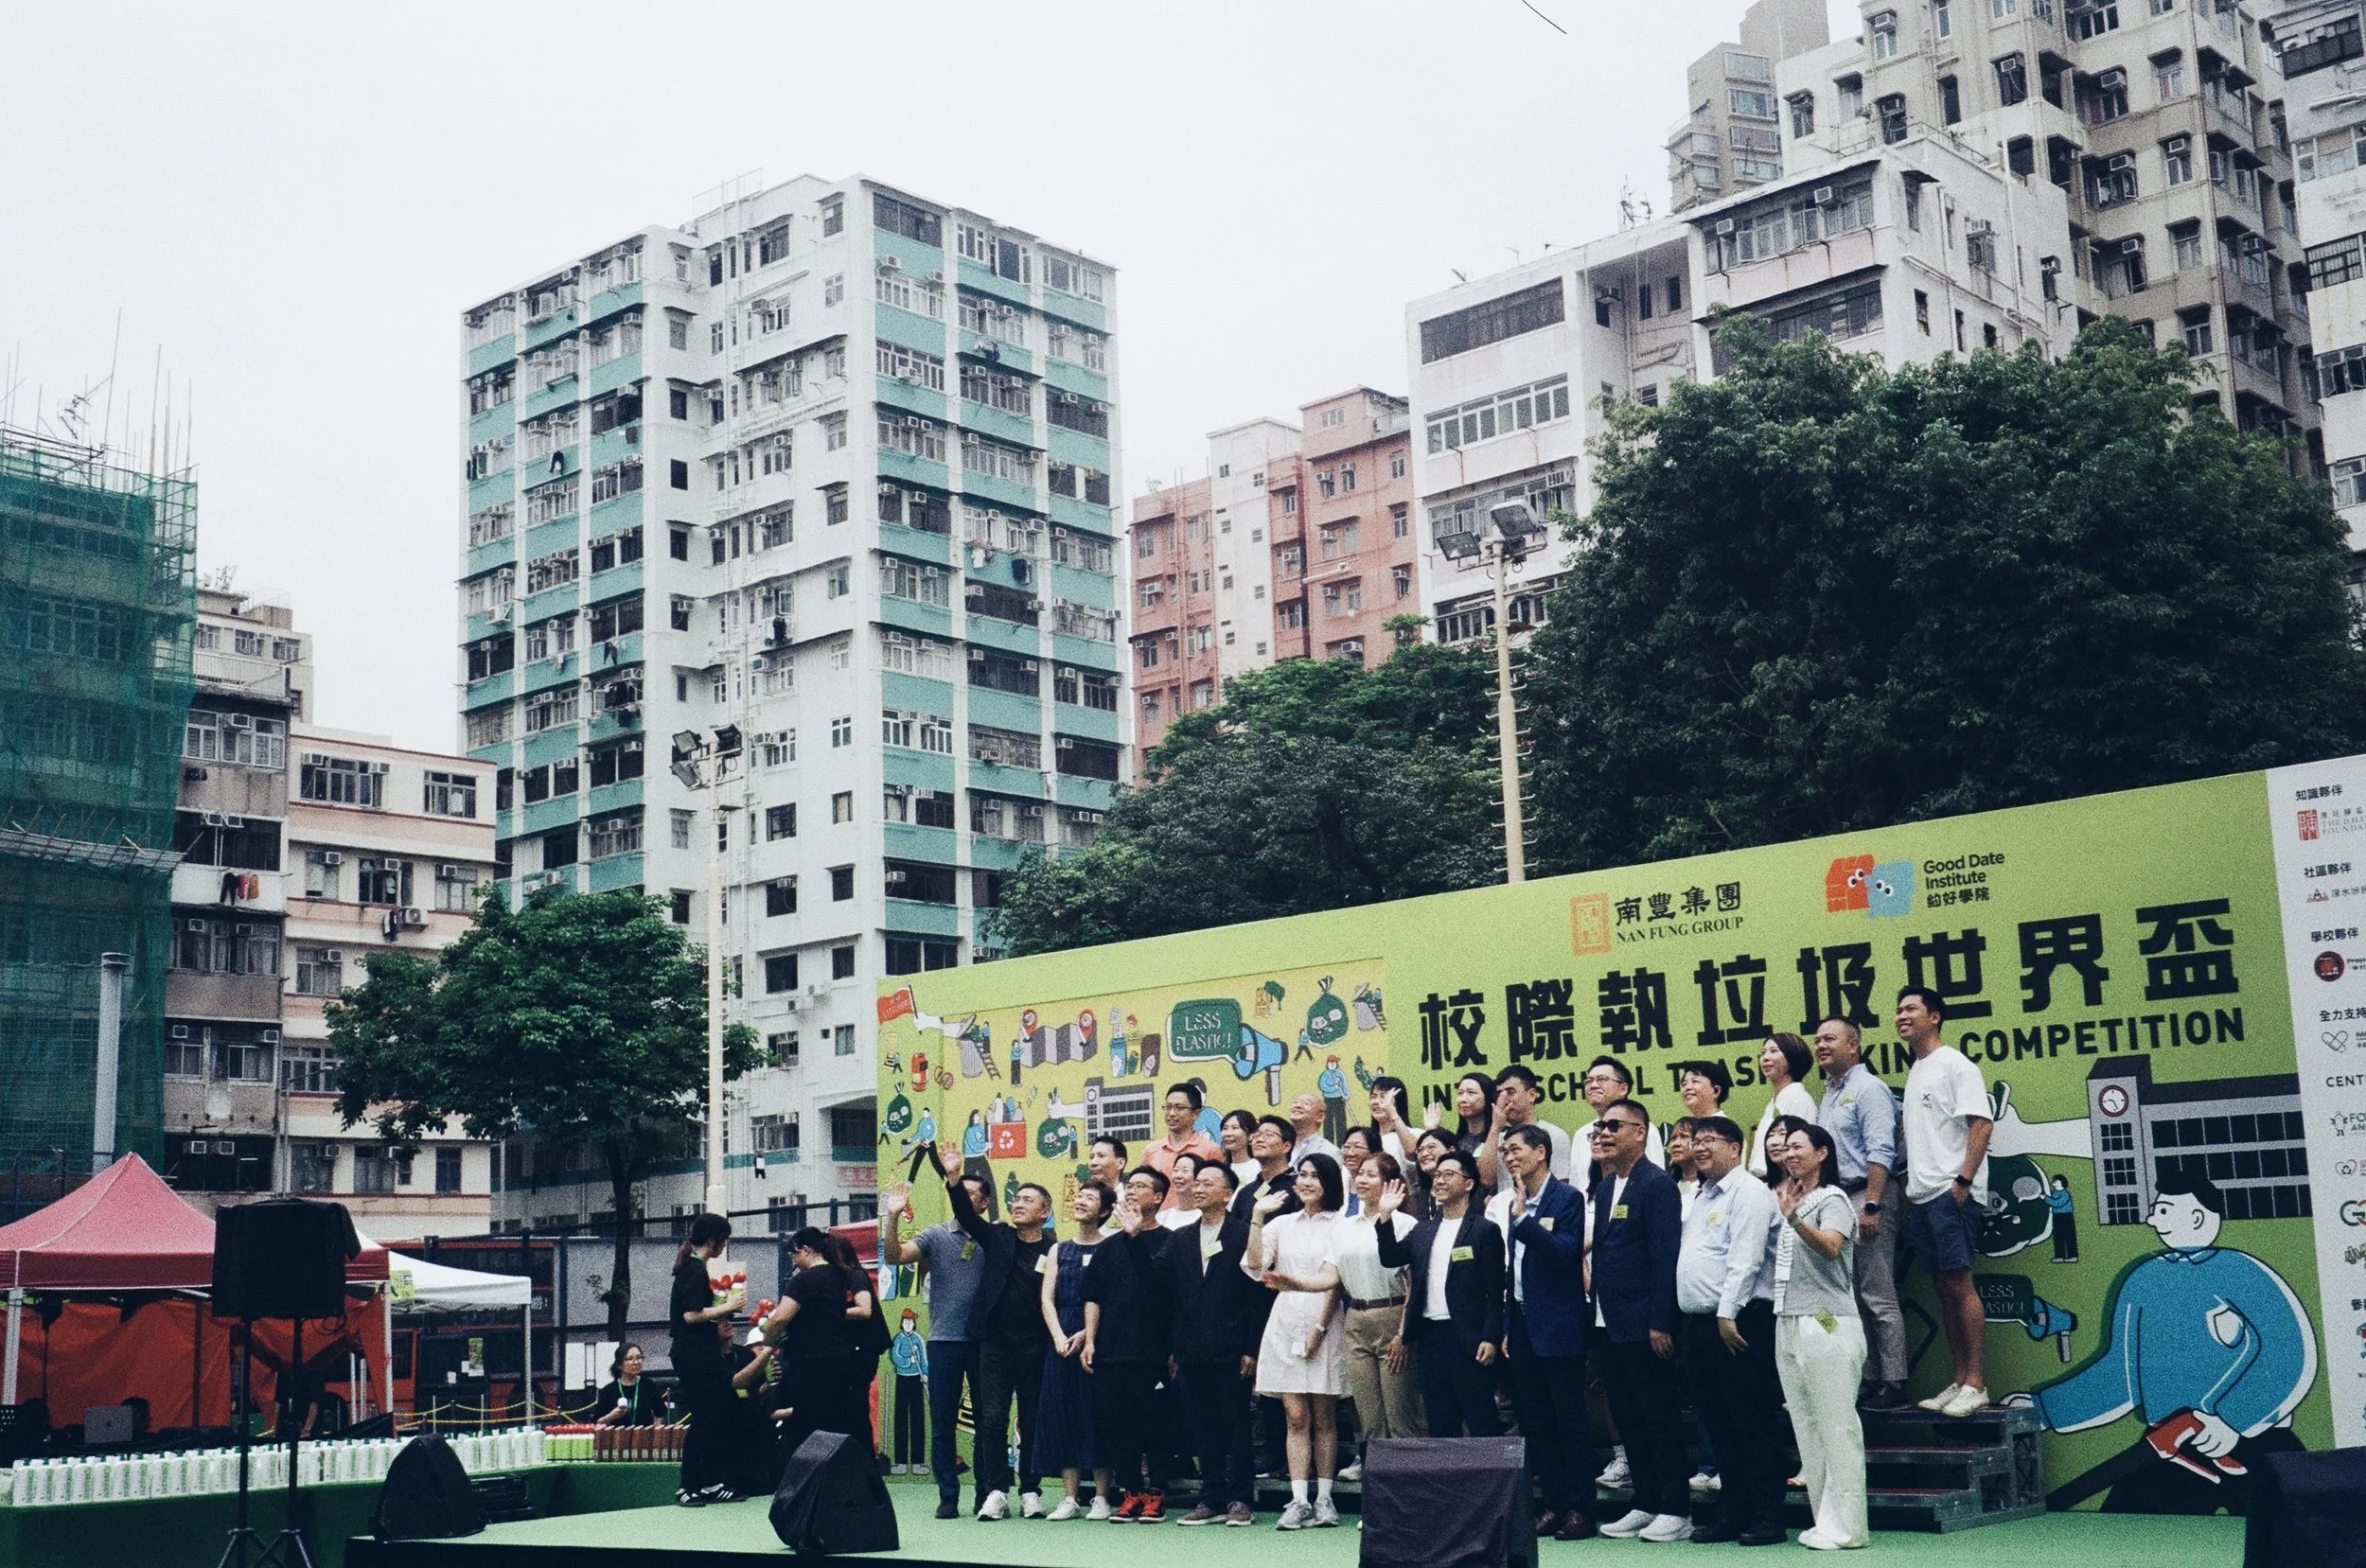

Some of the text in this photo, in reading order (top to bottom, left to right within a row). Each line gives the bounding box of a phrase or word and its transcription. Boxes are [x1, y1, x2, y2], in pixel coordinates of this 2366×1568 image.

[2296, 784, 2343, 802] 知識夥伴
[1923, 852, 2005, 874] Good Date
[2304, 862, 2352, 878] 社區夥伴
[1925, 871, 1986, 890] Institute
[1615, 881, 1741, 926] 南豐集團
[1927, 887, 1990, 908] 約好學院
[1616, 916, 1743, 944] NAN FUNG GROUP
[2311, 927, 2358, 943] 學校夥伴
[1419, 897, 2240, 1070] 校際執垃圾世界盃
[1185, 1013, 1221, 1031] LESS
[2320, 1006, 2366, 1022] 全力支持
[1176, 1032, 1231, 1051] PLASTIC!
[1959, 1007, 2245, 1064] COMPETITION
[2325, 1074, 2366, 1087] CENT
[1979, 1284, 2014, 1298] LESS
[1986, 1301, 2023, 1314] ASTIC!
